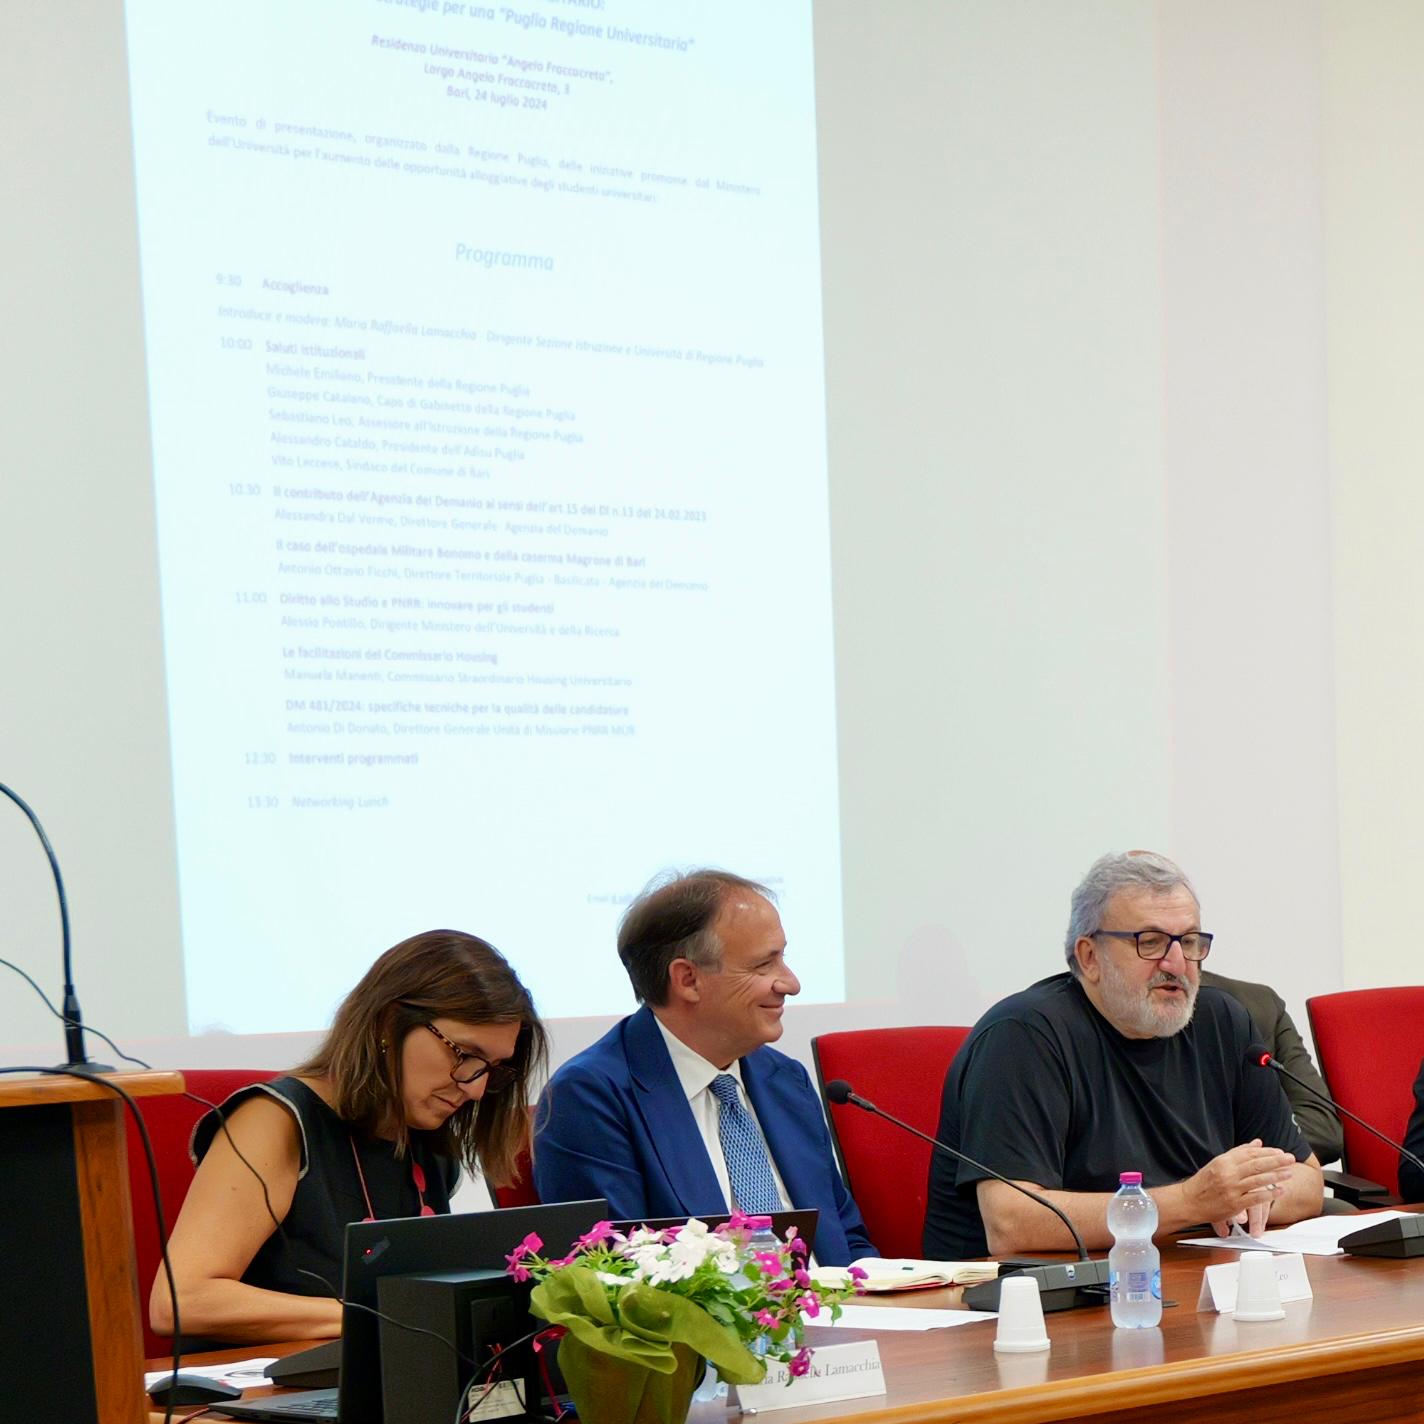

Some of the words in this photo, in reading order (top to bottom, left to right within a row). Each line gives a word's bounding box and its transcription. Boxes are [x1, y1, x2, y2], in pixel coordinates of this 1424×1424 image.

[443, 1, 465, 15] per
[470, 6, 495, 20] una
[500, 7, 547, 29] "Puglia
[551, 16, 603, 38] Regione
[371, 34, 426, 54] Residenza
[430, 45, 499, 64] Universitaria
[424, 64, 454, 79] Largo
[458, 68, 495, 84] Angelo
[491, 92, 519, 107] luglio
[522, 96, 547, 110] 2024
[206, 110, 247, 127] Evento
[275, 123, 356, 143] presentazione,
[365, 135, 427, 151] organizzato
[435, 143, 460, 155] dalla
[468, 146, 509, 161] Regione
[518, 153, 550, 168] Puglia,
[559, 160, 583, 171] delle
[590, 165, 633, 178] iniziative
[293, 148, 312, 159] per
[315, 148, 371, 166] l'aumento
[374, 157, 400, 170] delle
[403, 163, 467, 179] opportunità
[470, 170, 527, 186] alloggiative
[531, 177, 555, 192] degli
[456, 242, 554, 271] Programma
[826, 1358, 880, 1377] Lamacchia
